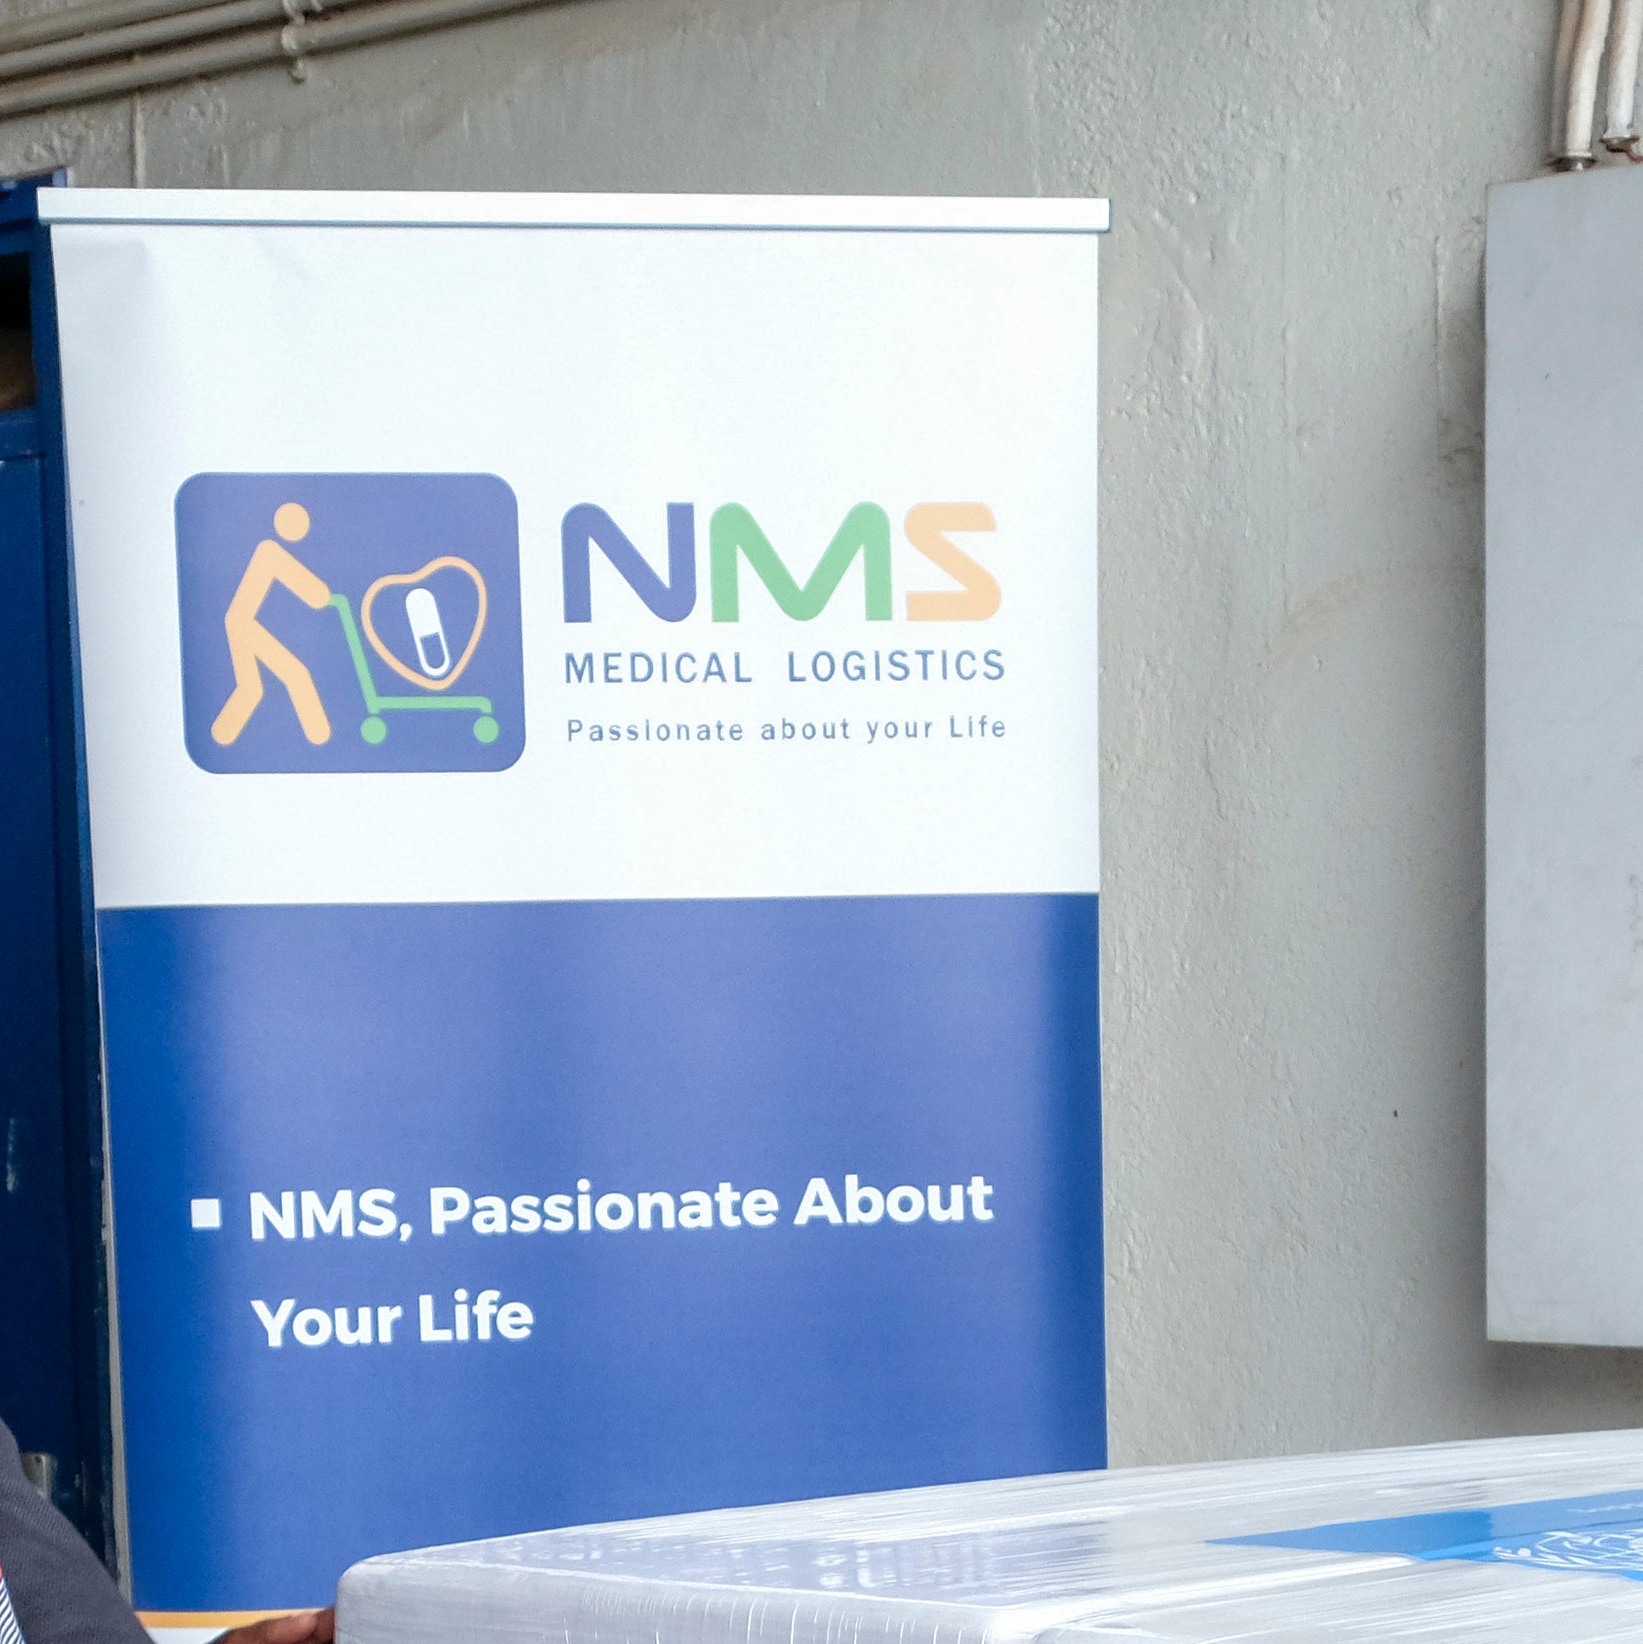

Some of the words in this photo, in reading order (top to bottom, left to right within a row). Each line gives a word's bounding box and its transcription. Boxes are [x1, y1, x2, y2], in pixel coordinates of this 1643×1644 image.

[560, 500, 1002, 623] NMS
[565, 651, 752, 683] MEDICAL
[786, 649, 1006, 682] LOGISTICS
[567, 716, 744, 743] Passionate
[761, 714, 851, 741] about
[865, 718, 933, 745] your
[948, 712, 1007, 740] Life
[250, 1187, 414, 1243] NMS,
[428, 1177, 779, 1234] Passionate
[794, 1173, 994, 1225] About
[252, 1296, 402, 1349] Your
[418, 1289, 533, 1341] Life
